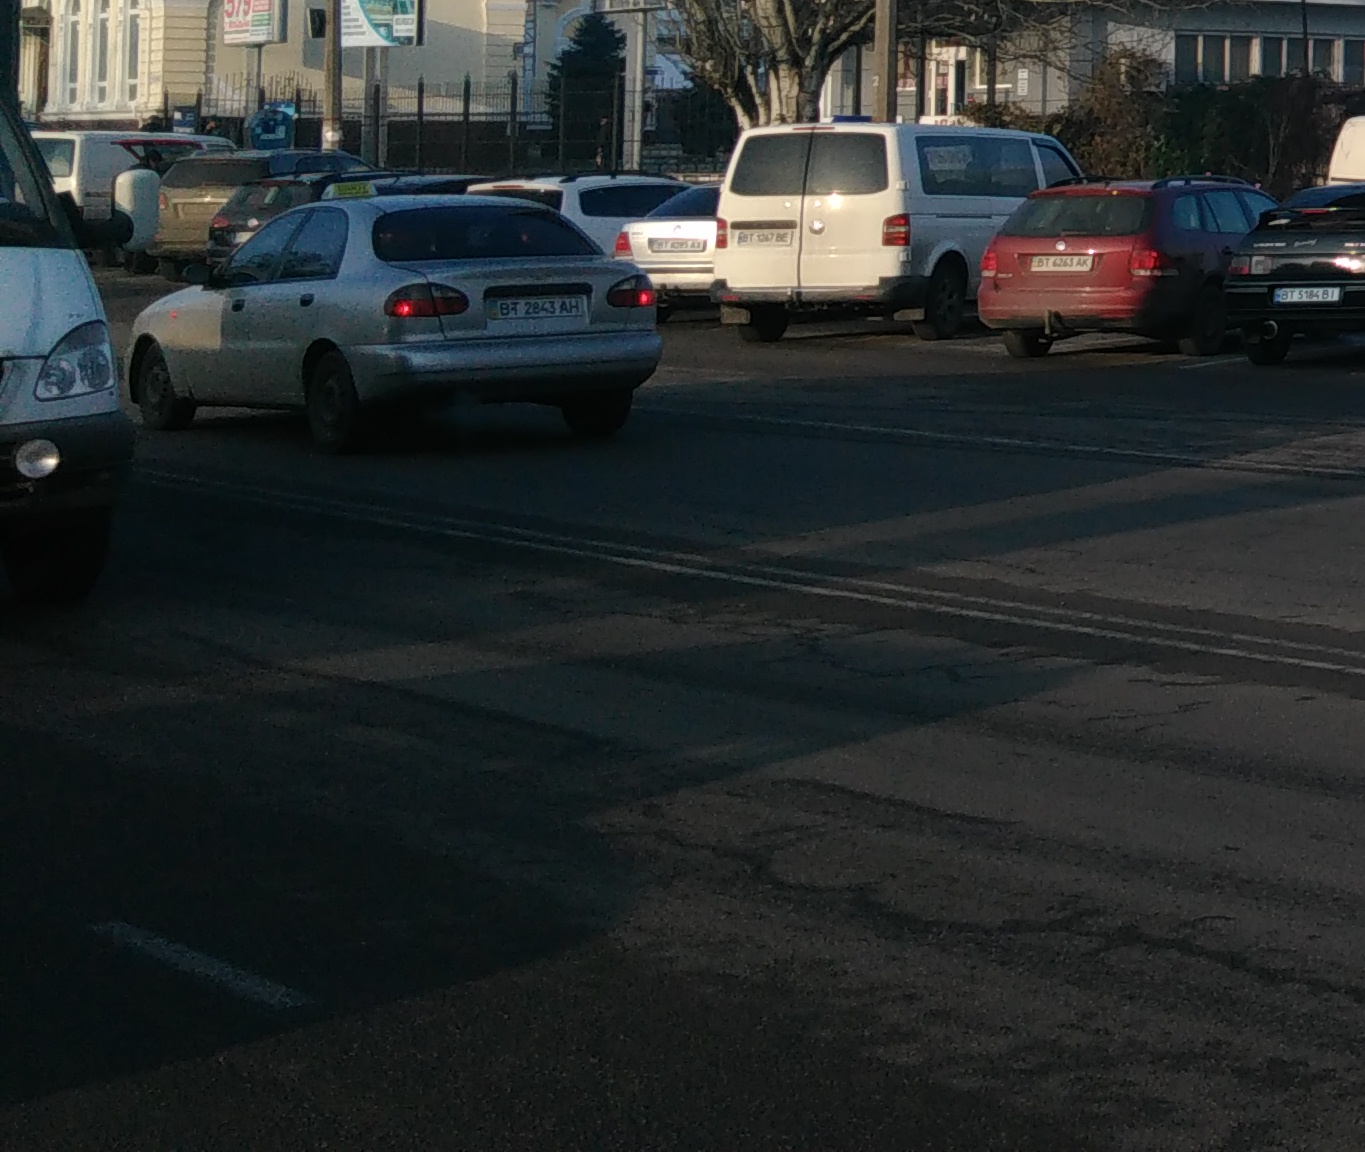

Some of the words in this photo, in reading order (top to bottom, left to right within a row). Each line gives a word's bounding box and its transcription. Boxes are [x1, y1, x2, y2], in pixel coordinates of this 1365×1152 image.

[1036, 257, 1051, 268] BT
[1076, 258, 1090, 268] AK
[1281, 290, 1296, 301] BT
[500, 301, 519, 316] BT
